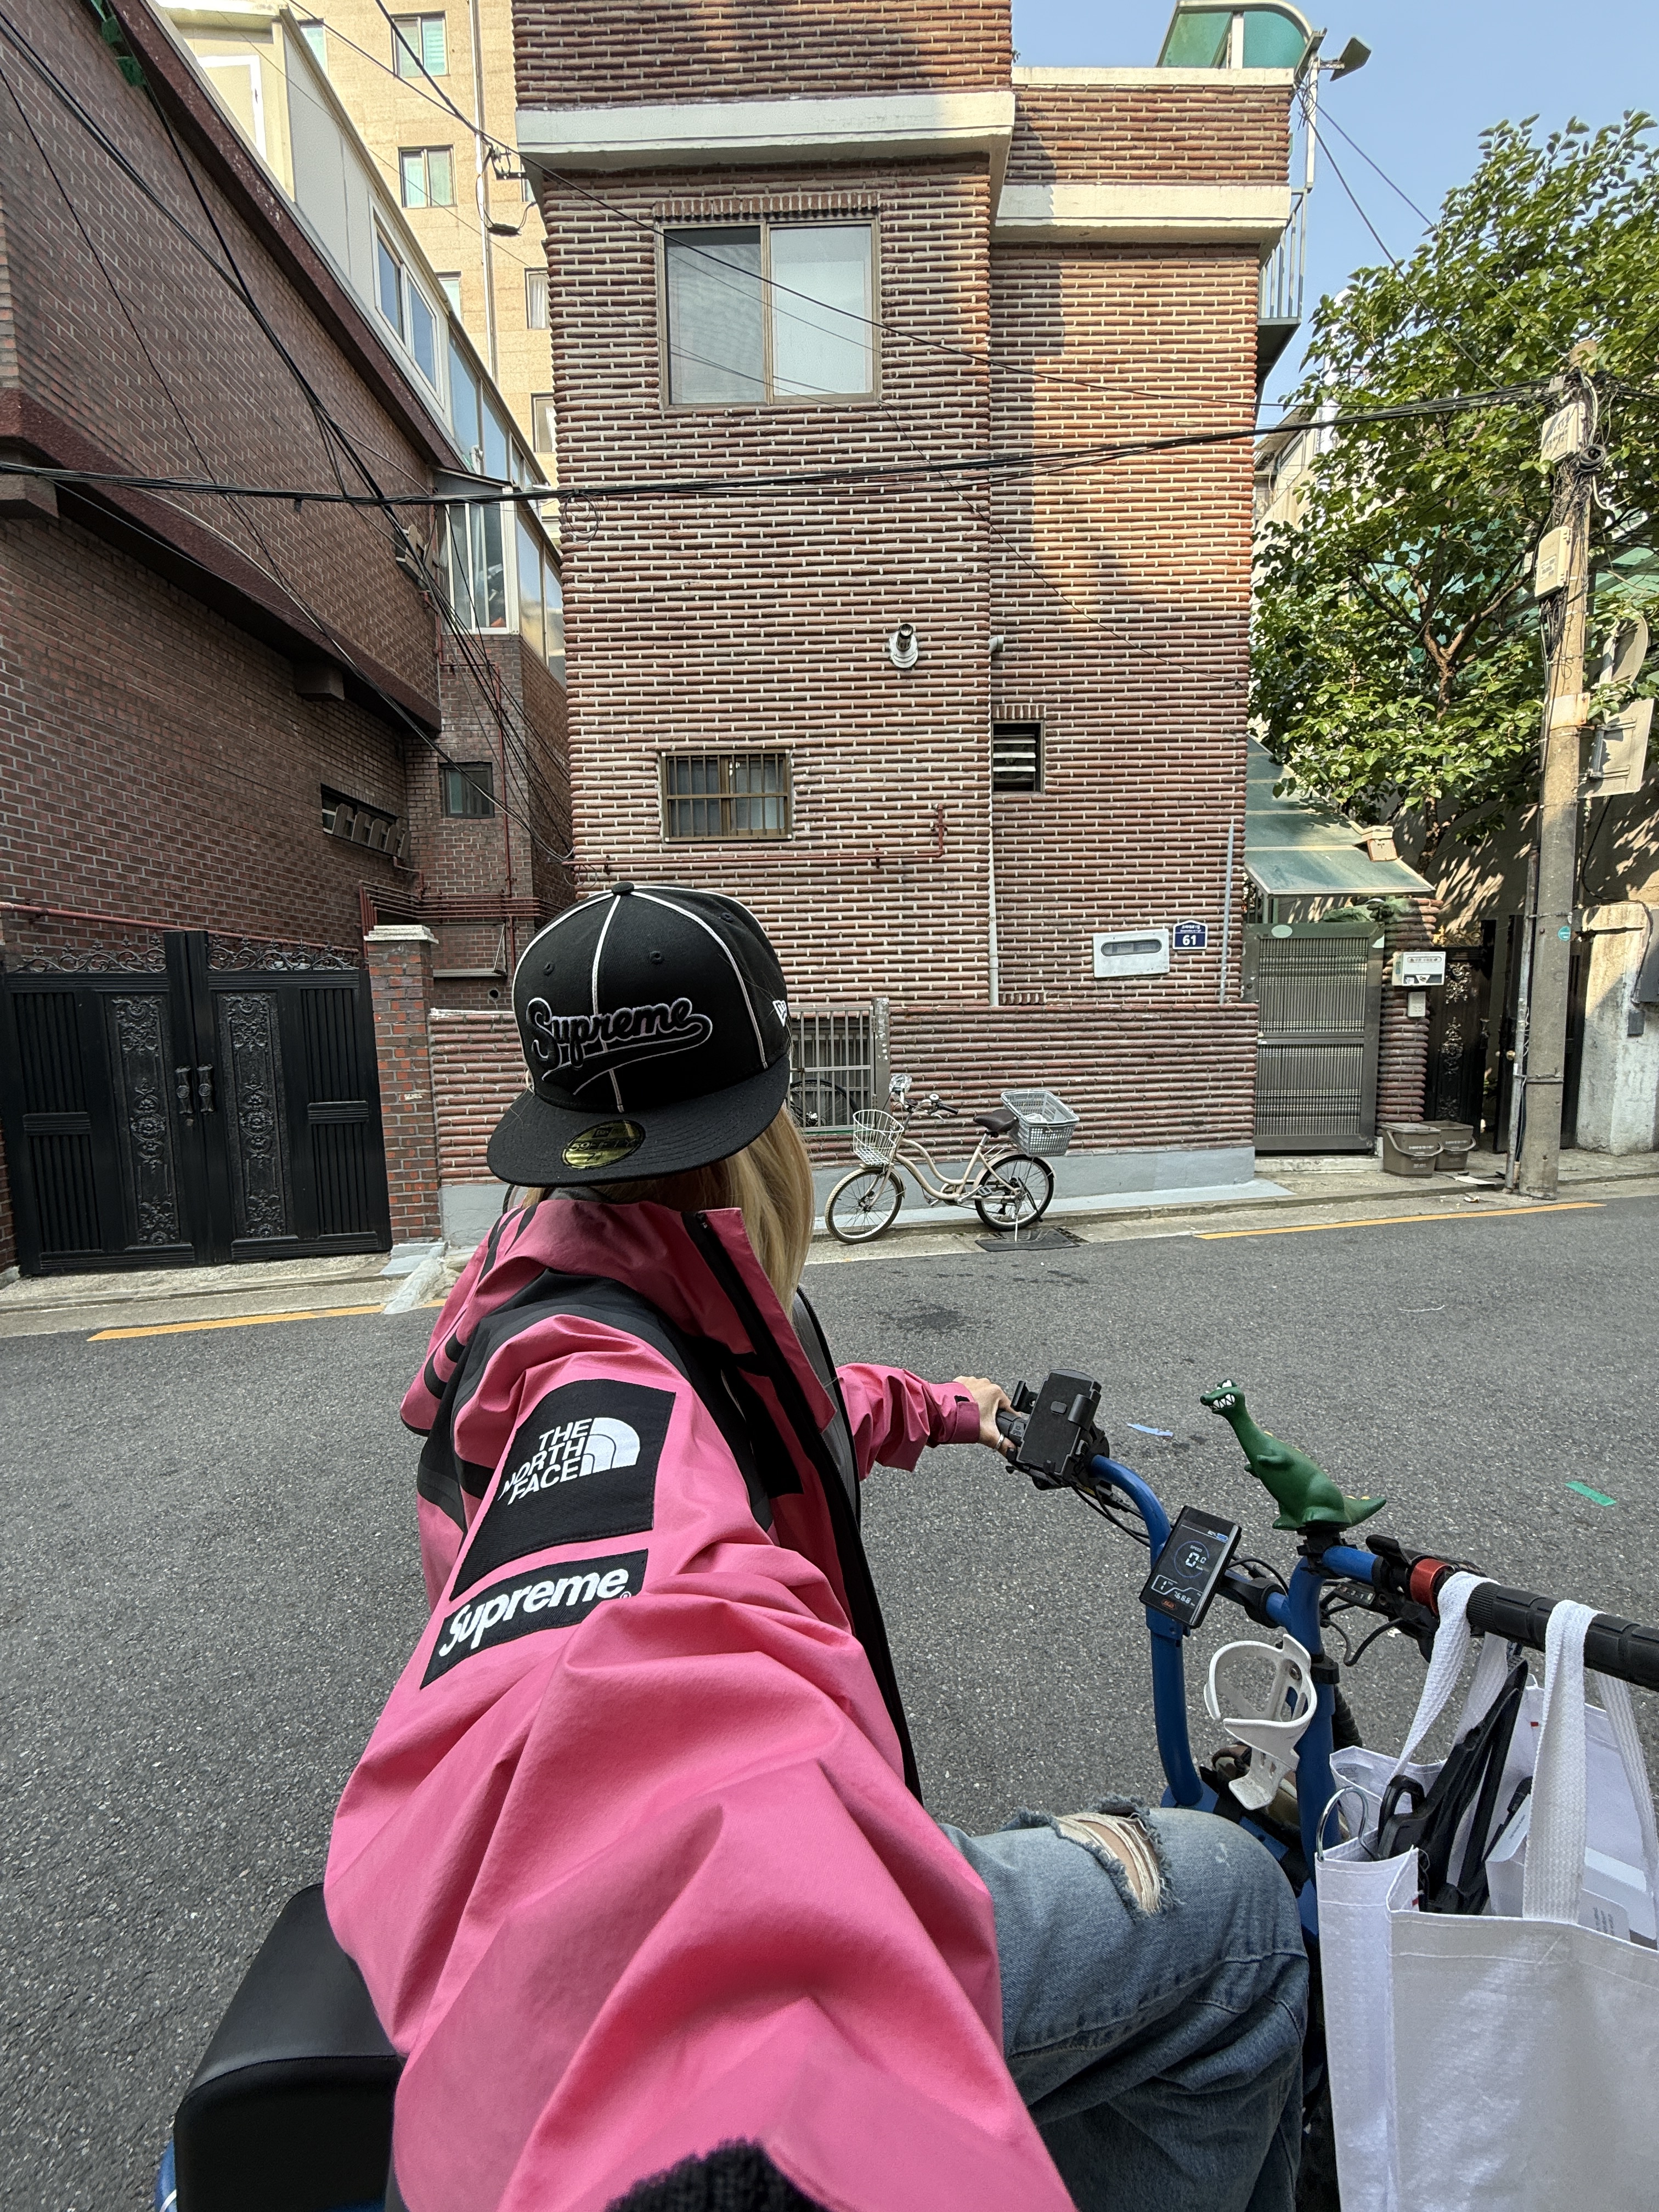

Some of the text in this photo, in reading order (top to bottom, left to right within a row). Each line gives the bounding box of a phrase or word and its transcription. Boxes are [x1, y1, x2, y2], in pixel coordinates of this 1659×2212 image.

[1182, 934, 1197, 946] 61
[526, 997, 712, 1079] Supreme
[539, 1418, 592, 1451] THE
[497, 1437, 585, 1502] NORTH
[507, 1457, 580, 1505] FACE
[439, 1568, 629, 1657] Supreme
